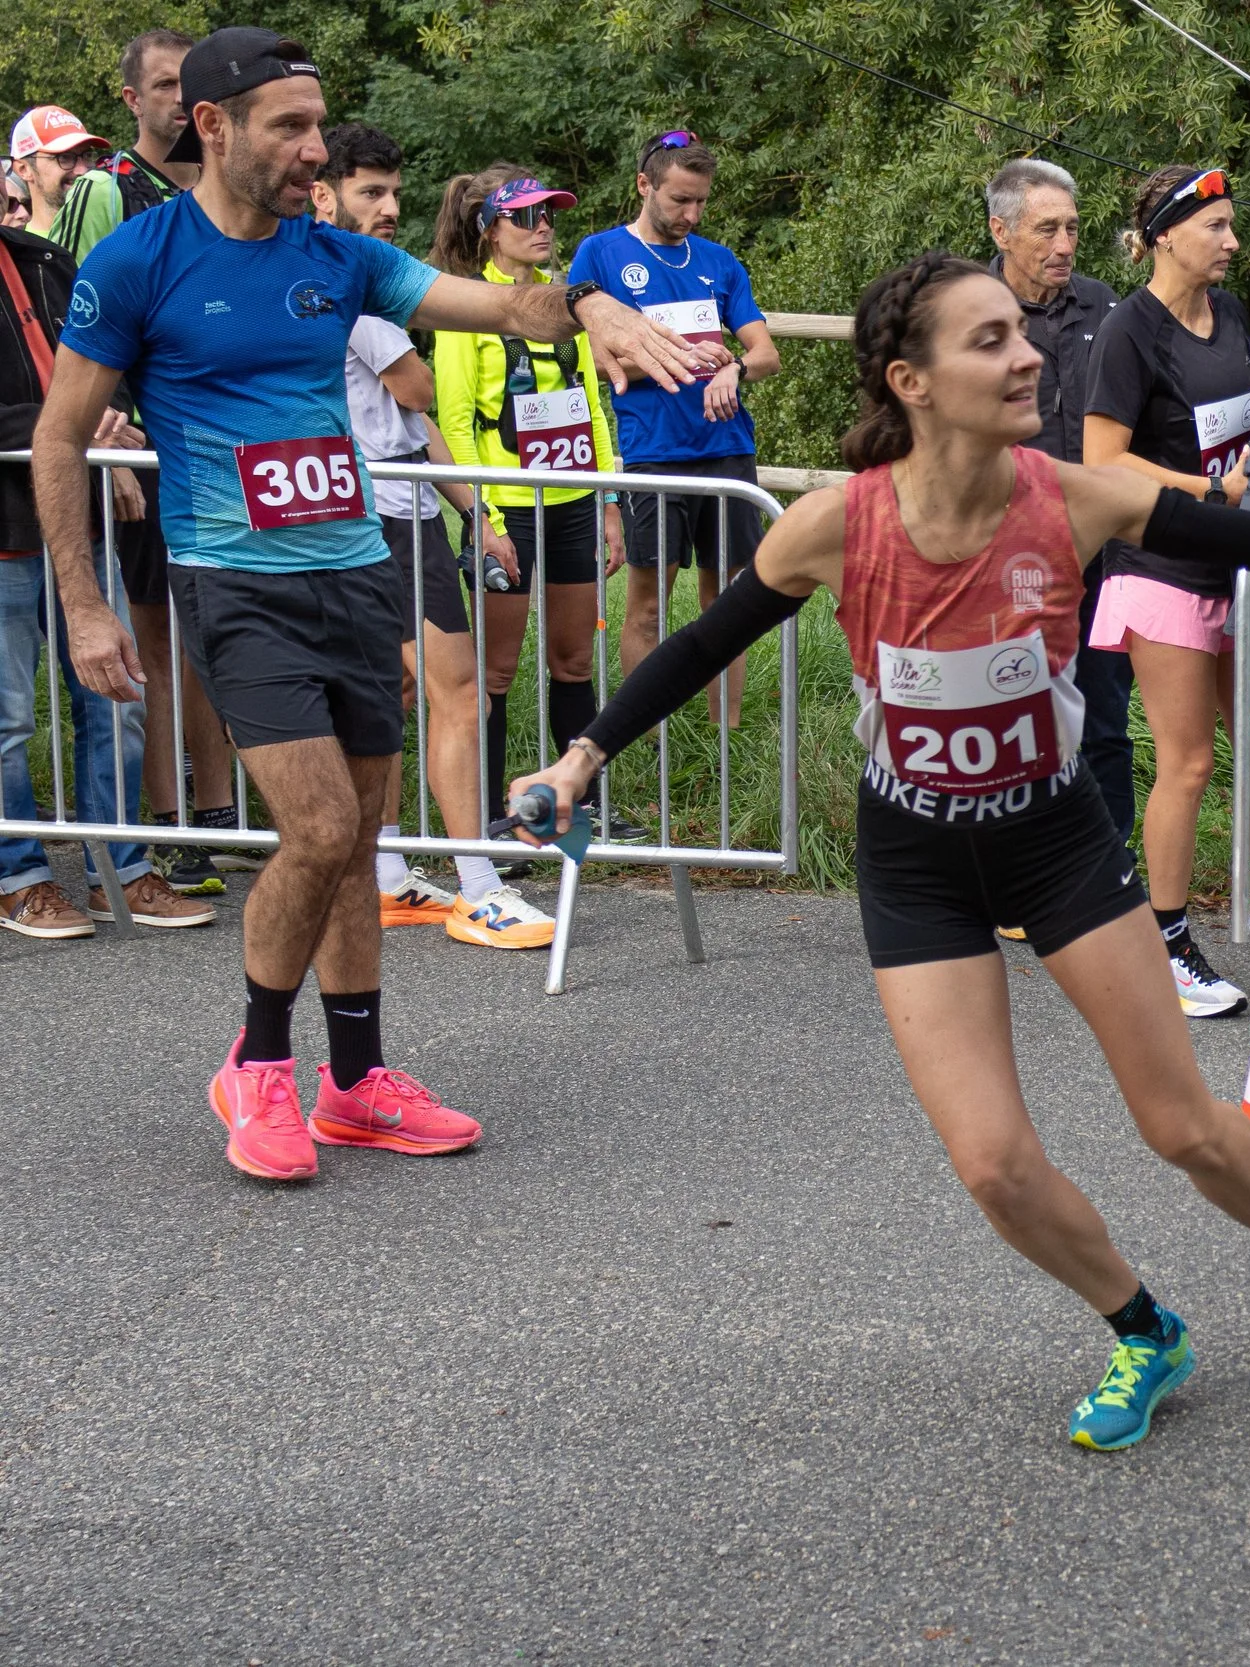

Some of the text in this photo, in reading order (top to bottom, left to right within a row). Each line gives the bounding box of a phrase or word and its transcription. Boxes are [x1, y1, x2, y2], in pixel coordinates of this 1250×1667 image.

[204, 300, 226, 309] tactic
[204, 306, 232, 315] projects
[523, 402, 539, 414] Vin
[1205, 413, 1219, 429] Vin
[526, 434, 593, 470] 226
[252, 454, 356, 507] 305
[1012, 569, 1043, 588] RUN
[893, 659, 922, 681] Vin
[900, 714, 1038, 775] 201
[864, 756, 939, 818] NIKE
[946, 783, 1032, 822] PRO
